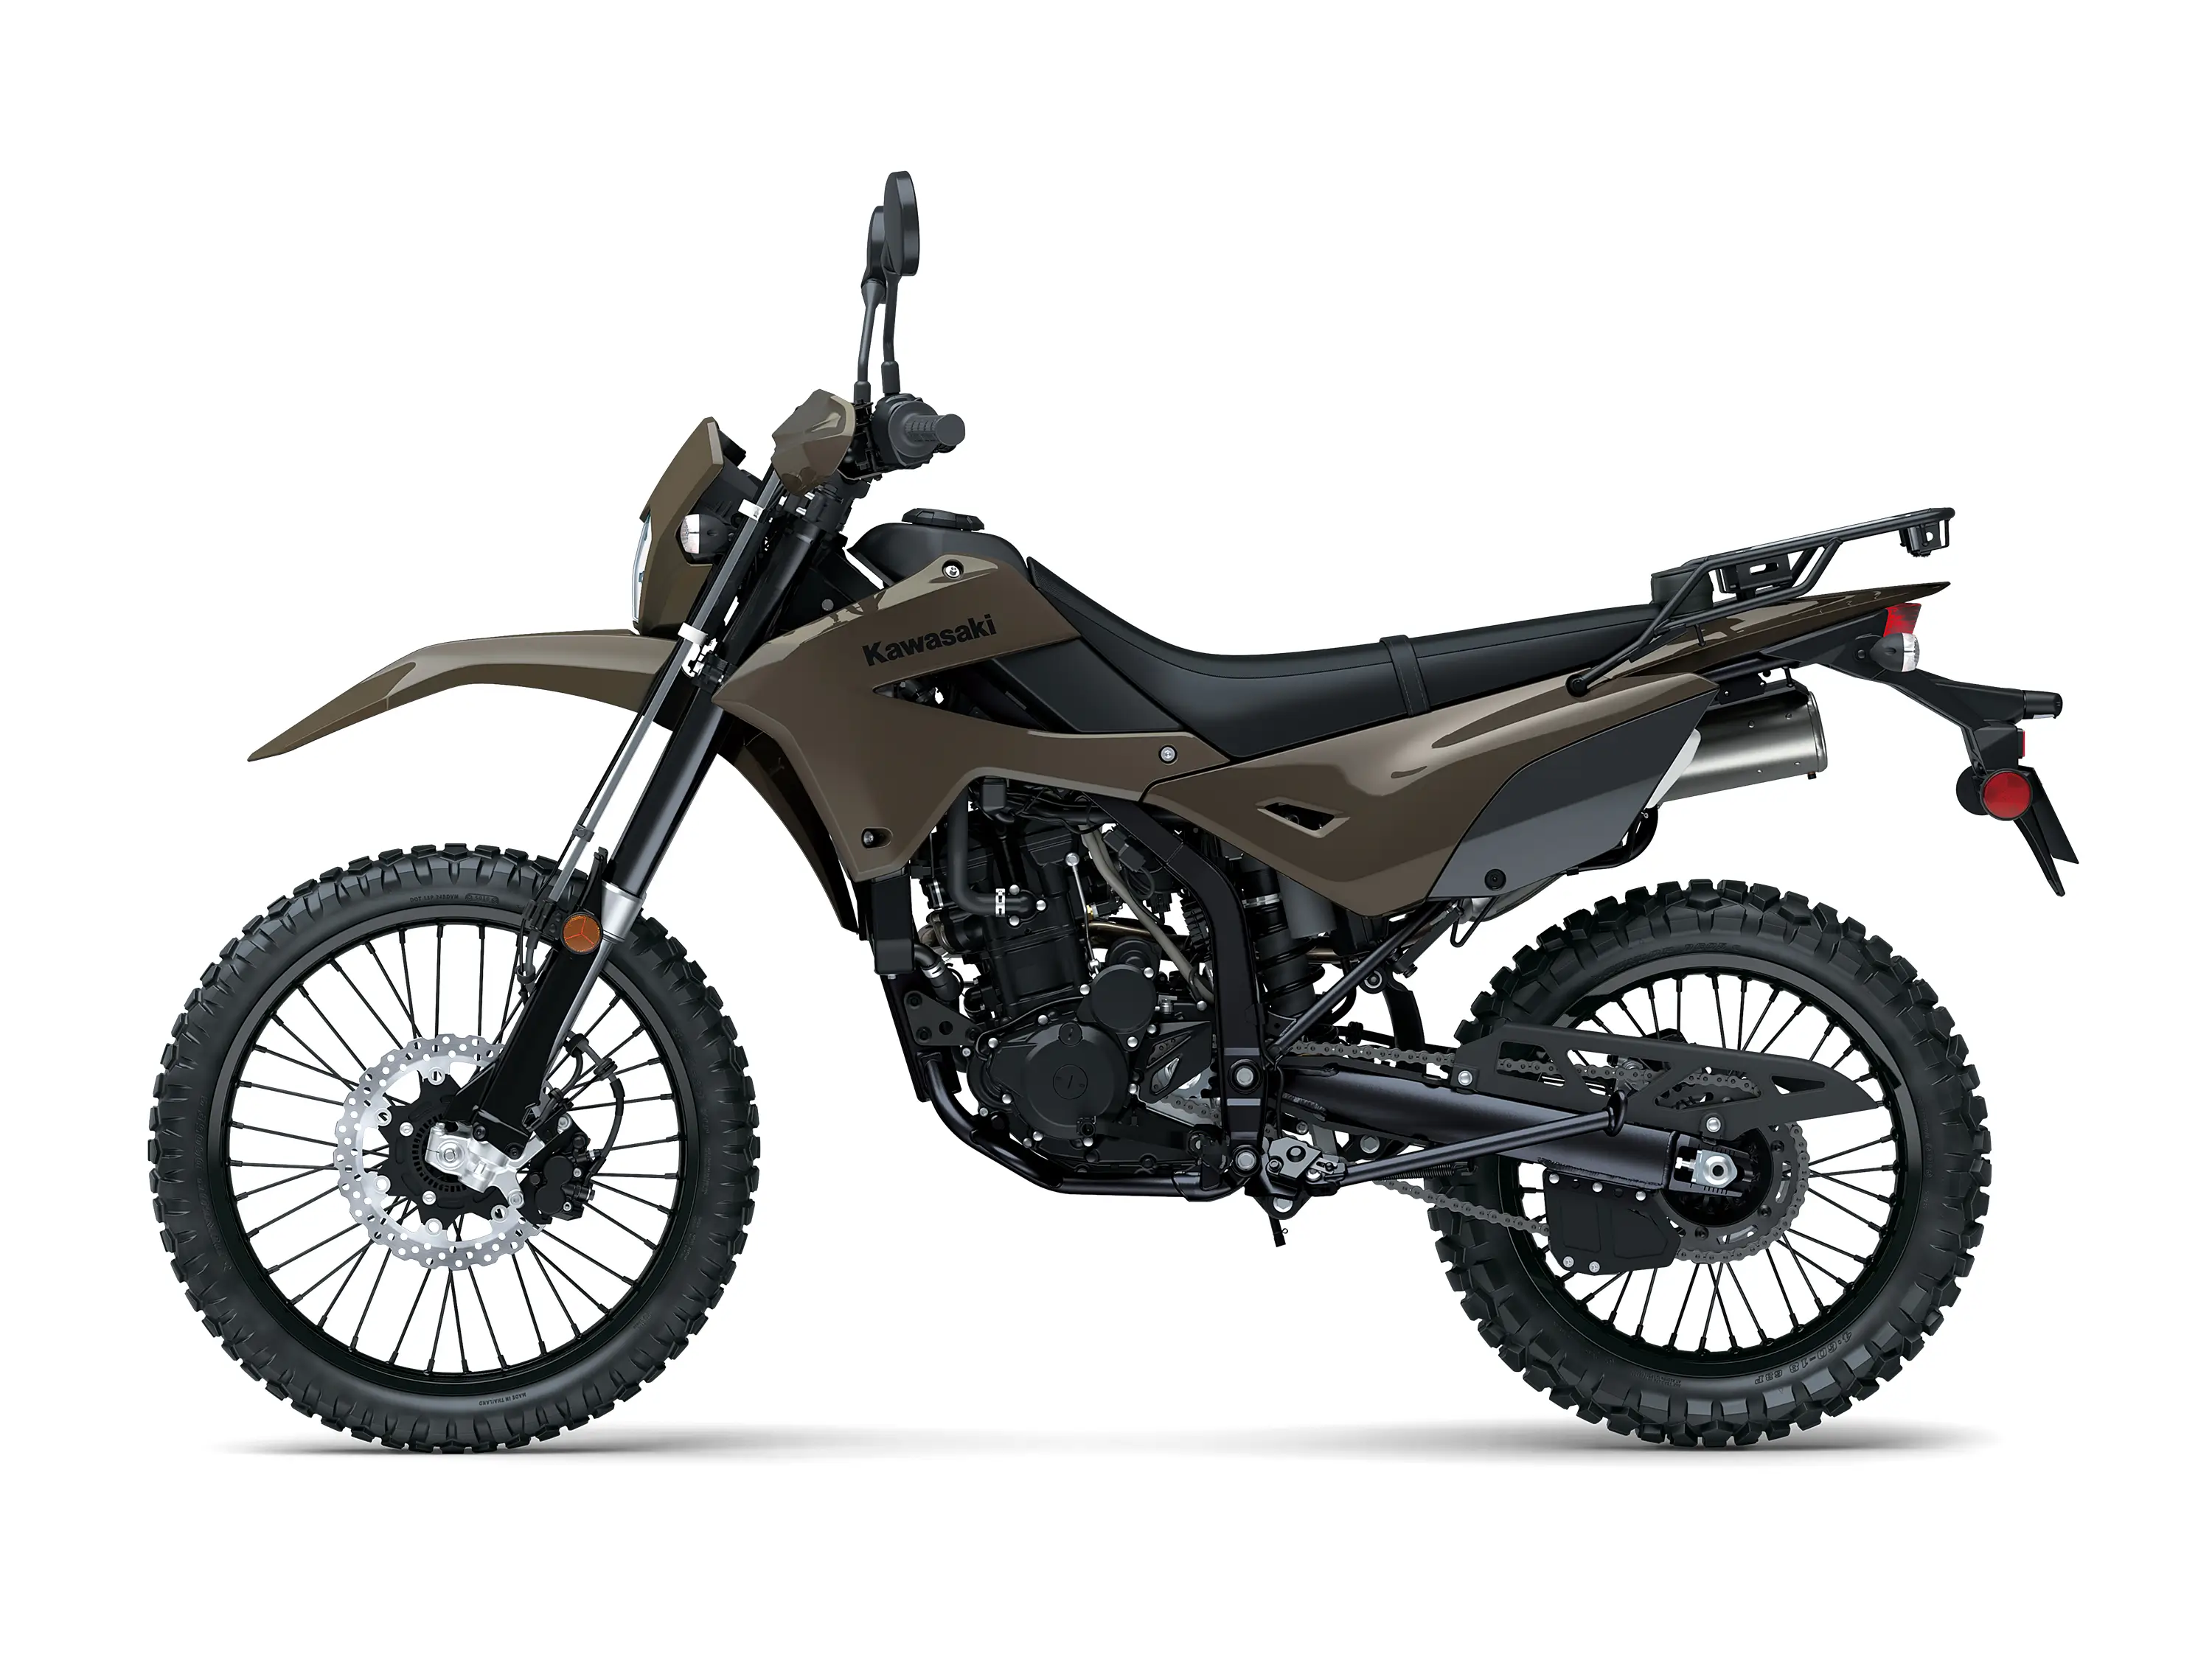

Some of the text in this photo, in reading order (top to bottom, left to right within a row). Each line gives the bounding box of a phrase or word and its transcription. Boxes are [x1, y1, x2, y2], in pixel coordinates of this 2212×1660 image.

[862, 614, 997, 666] Kawasaki
[1755, 1370, 1783, 1384] 63P
[479, 1398, 504, 1406] THAILAND
[512, 1392, 526, 1401] MADE
